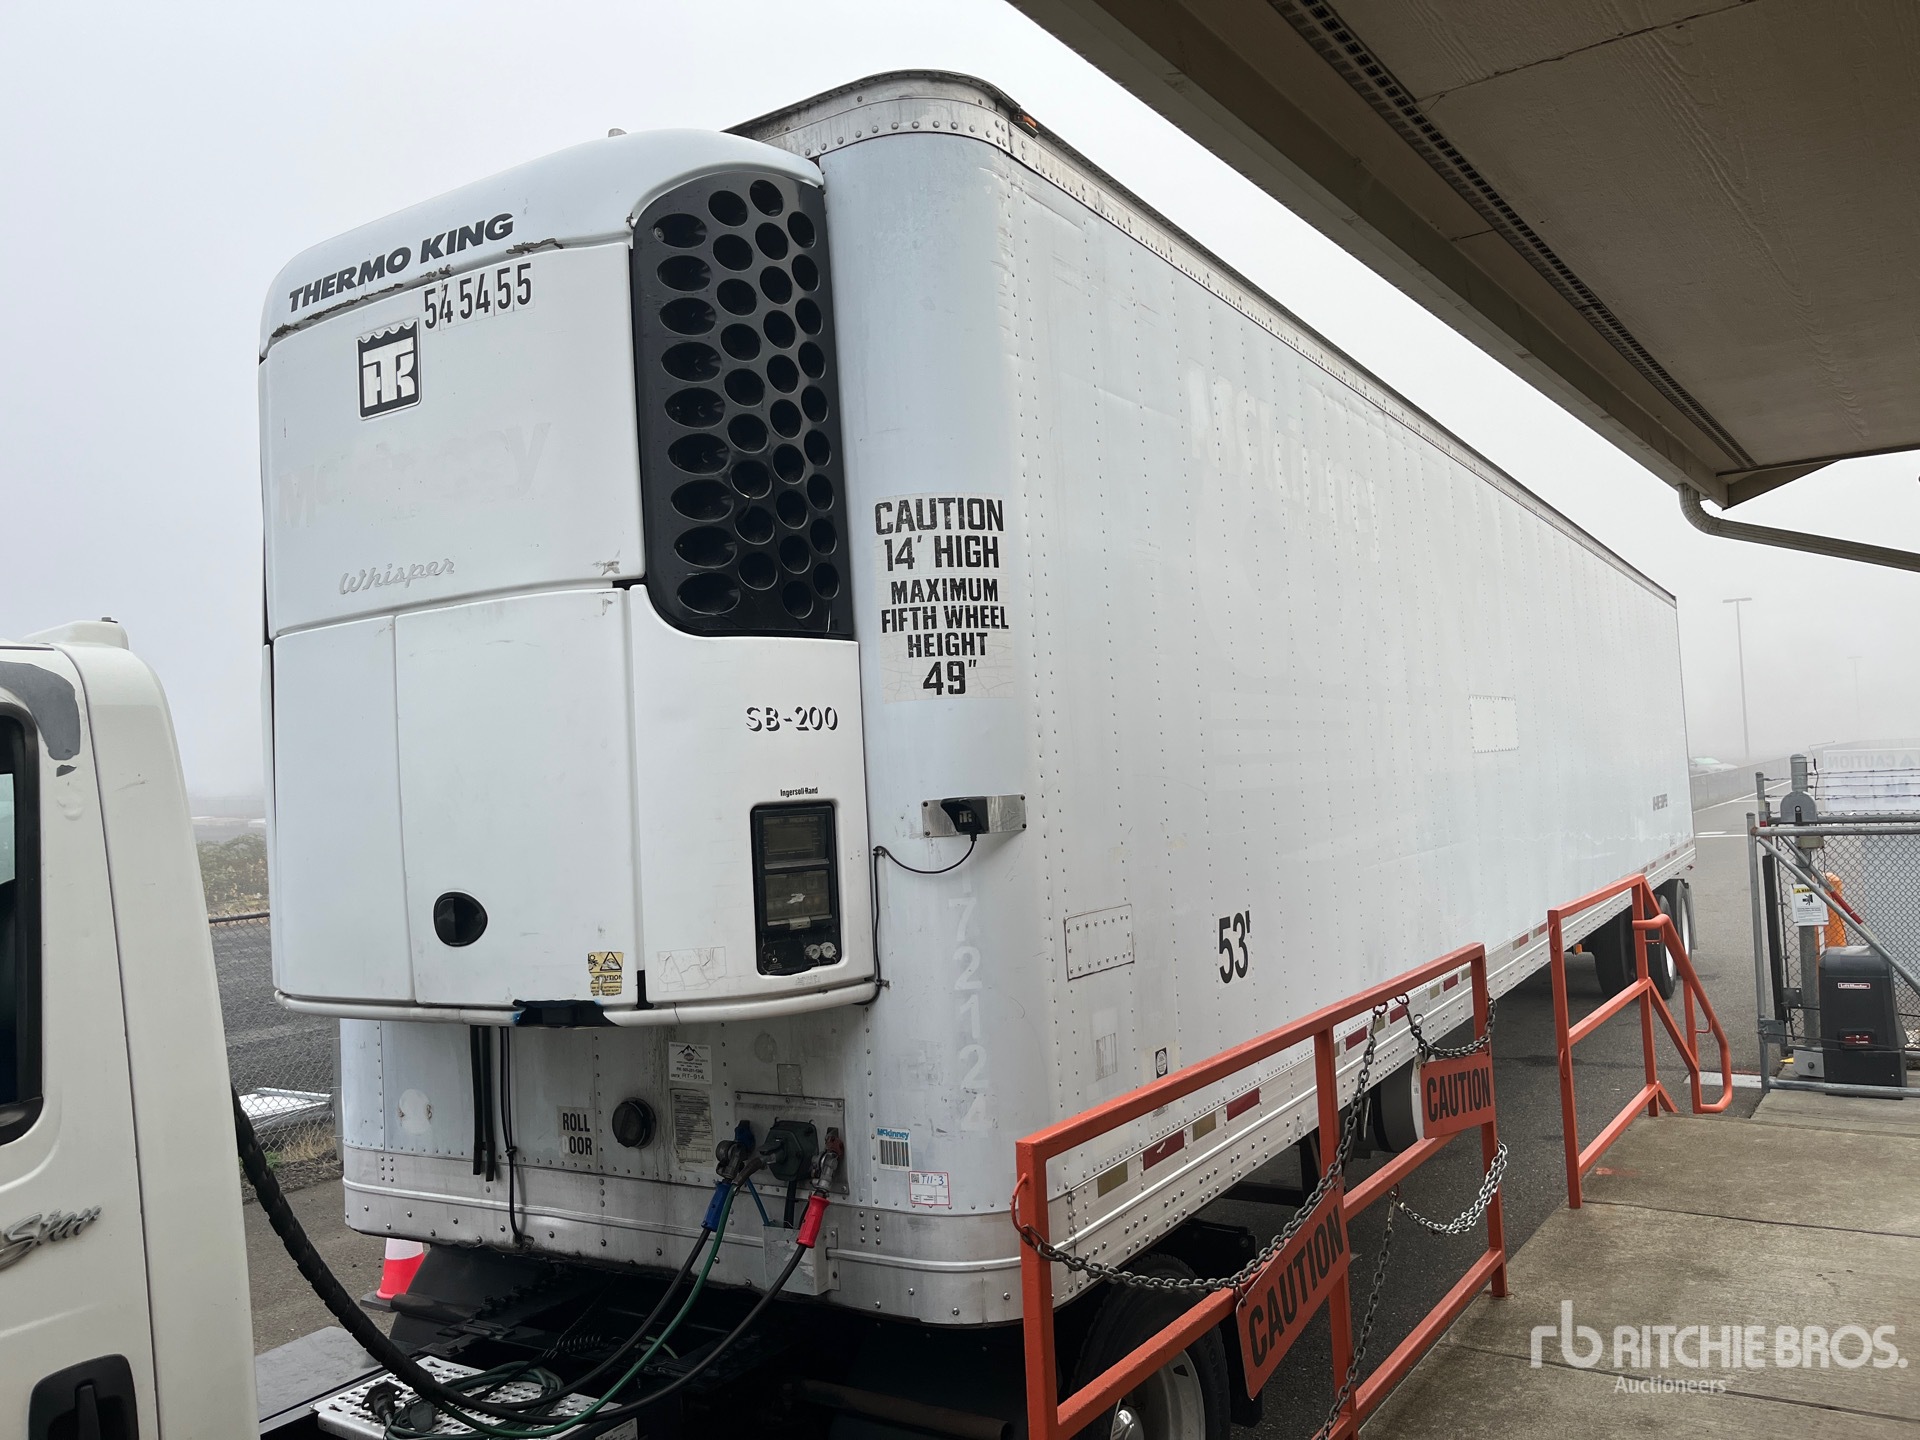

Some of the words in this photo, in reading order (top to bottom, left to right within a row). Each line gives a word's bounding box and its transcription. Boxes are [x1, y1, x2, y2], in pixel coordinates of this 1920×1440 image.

[289, 246, 411, 312] THERMO
[420, 213, 514, 264] KING
[424, 262, 532, 330] 545455
[874, 497, 1004, 535] CAUTION
[884, 535, 922, 572] 14'
[934, 535, 1000, 568] HIGH
[339, 558, 455, 595] Whisper
[890, 578, 999, 605] MAXIMUM
[881, 605, 938, 633] FIFTH
[943, 605, 1009, 630] WHEEL
[907, 632, 988, 658] HEIGHT
[922, 659, 977, 696] 49"
[746, 706, 839, 732] SB-200
[1217, 910, 1251, 985] 53'
[1427, 1067, 1491, 1122] CAUTION
[562, 1112, 590, 1132] ROLL
[1248, 1204, 1345, 1368] CAUTION
